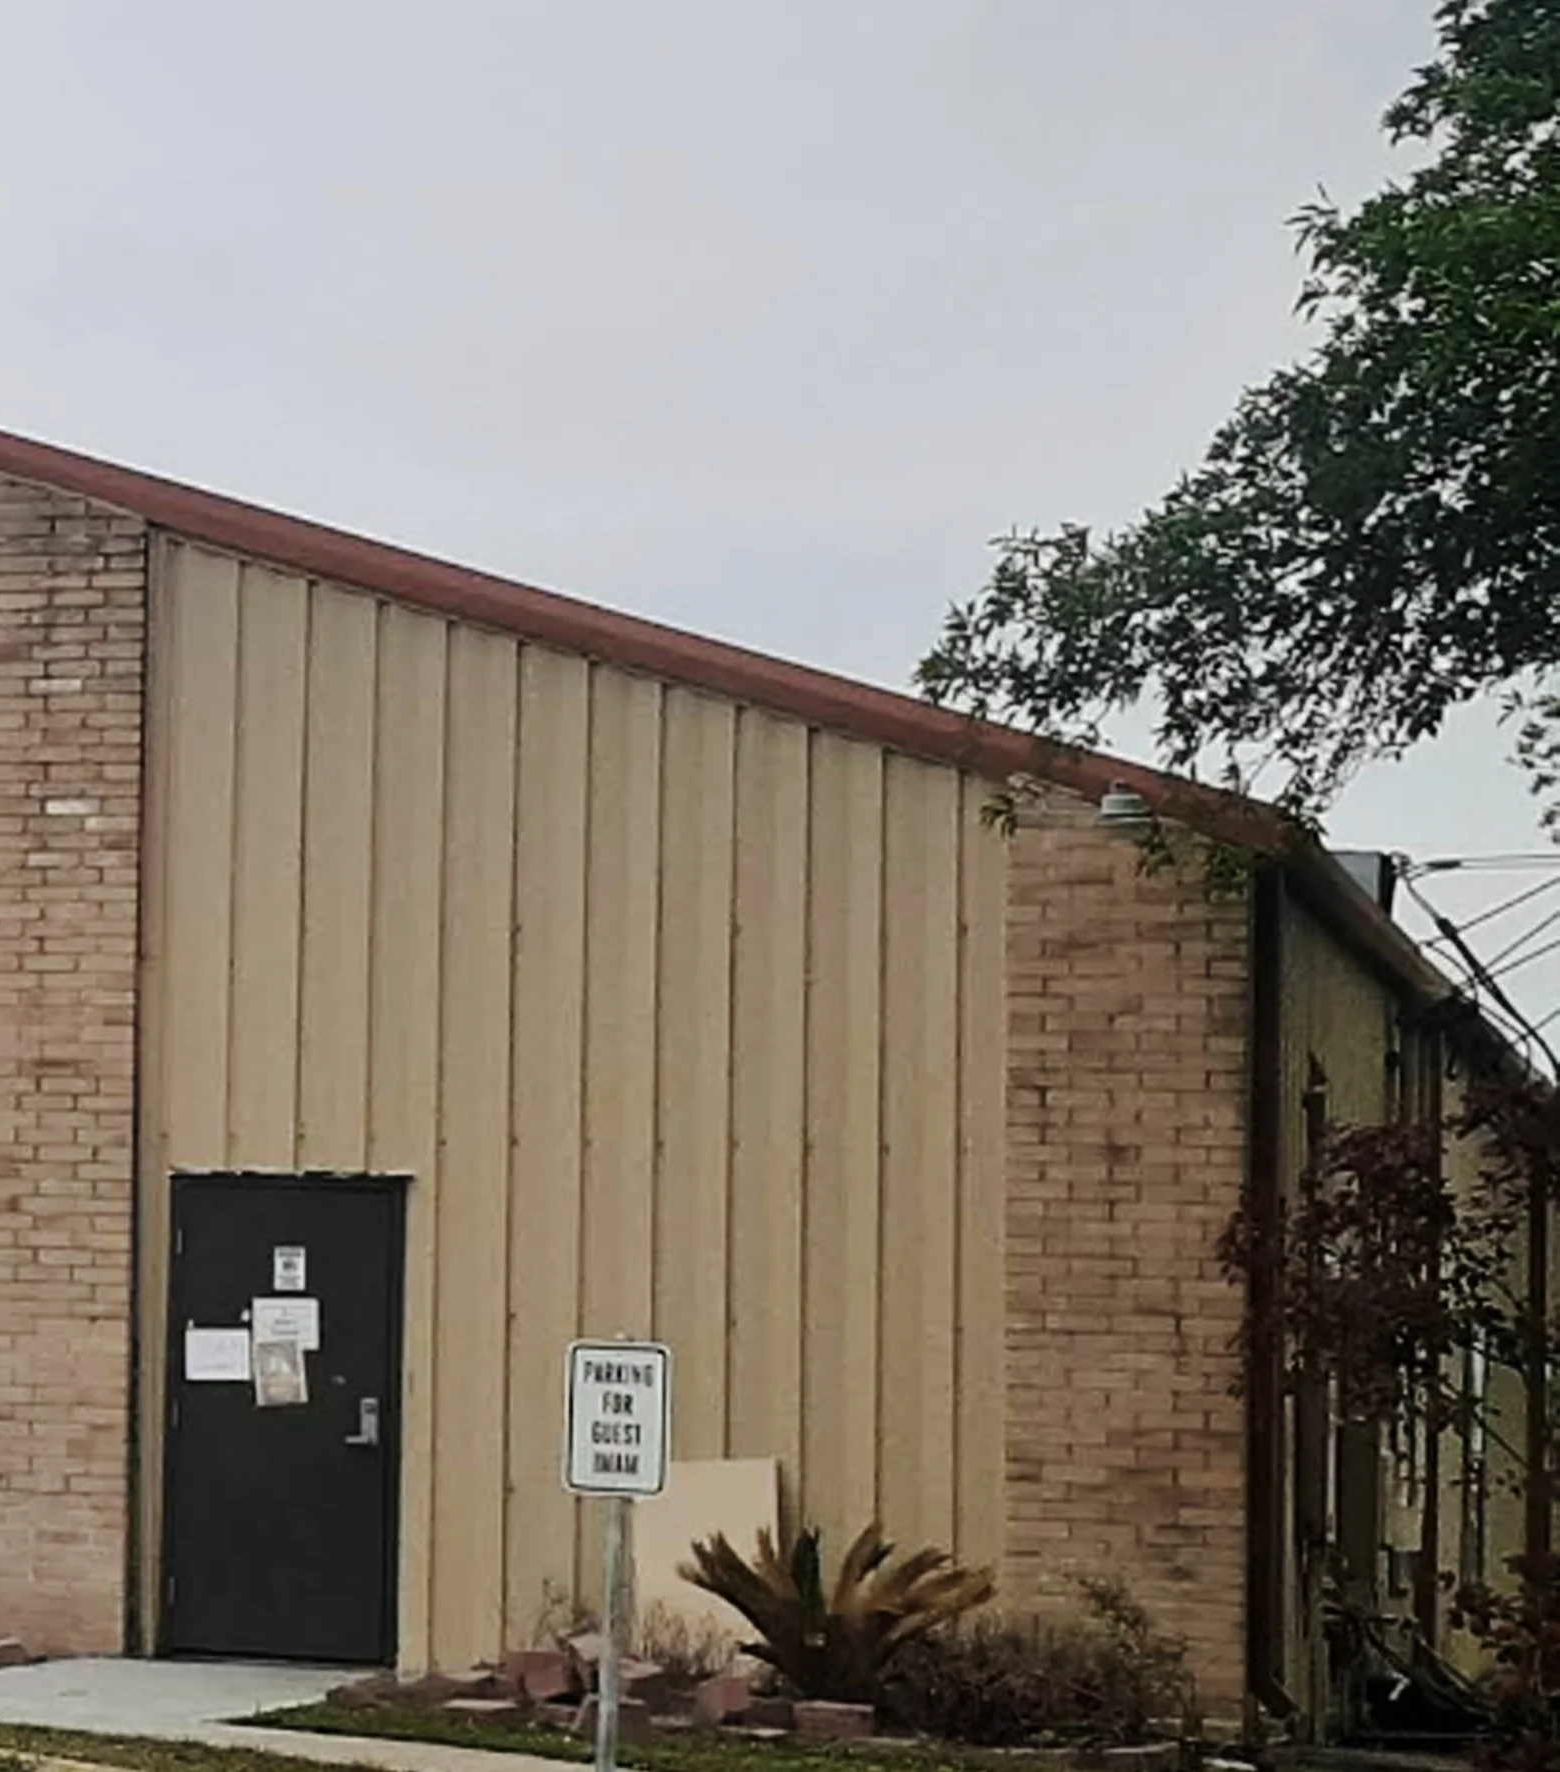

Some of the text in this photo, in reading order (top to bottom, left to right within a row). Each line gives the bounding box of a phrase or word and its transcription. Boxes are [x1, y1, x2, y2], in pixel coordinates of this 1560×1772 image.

[583, 1360, 654, 1387] PARKING
[602, 1391, 634, 1415] FOR
[592, 1420, 641, 1446] GUEST
